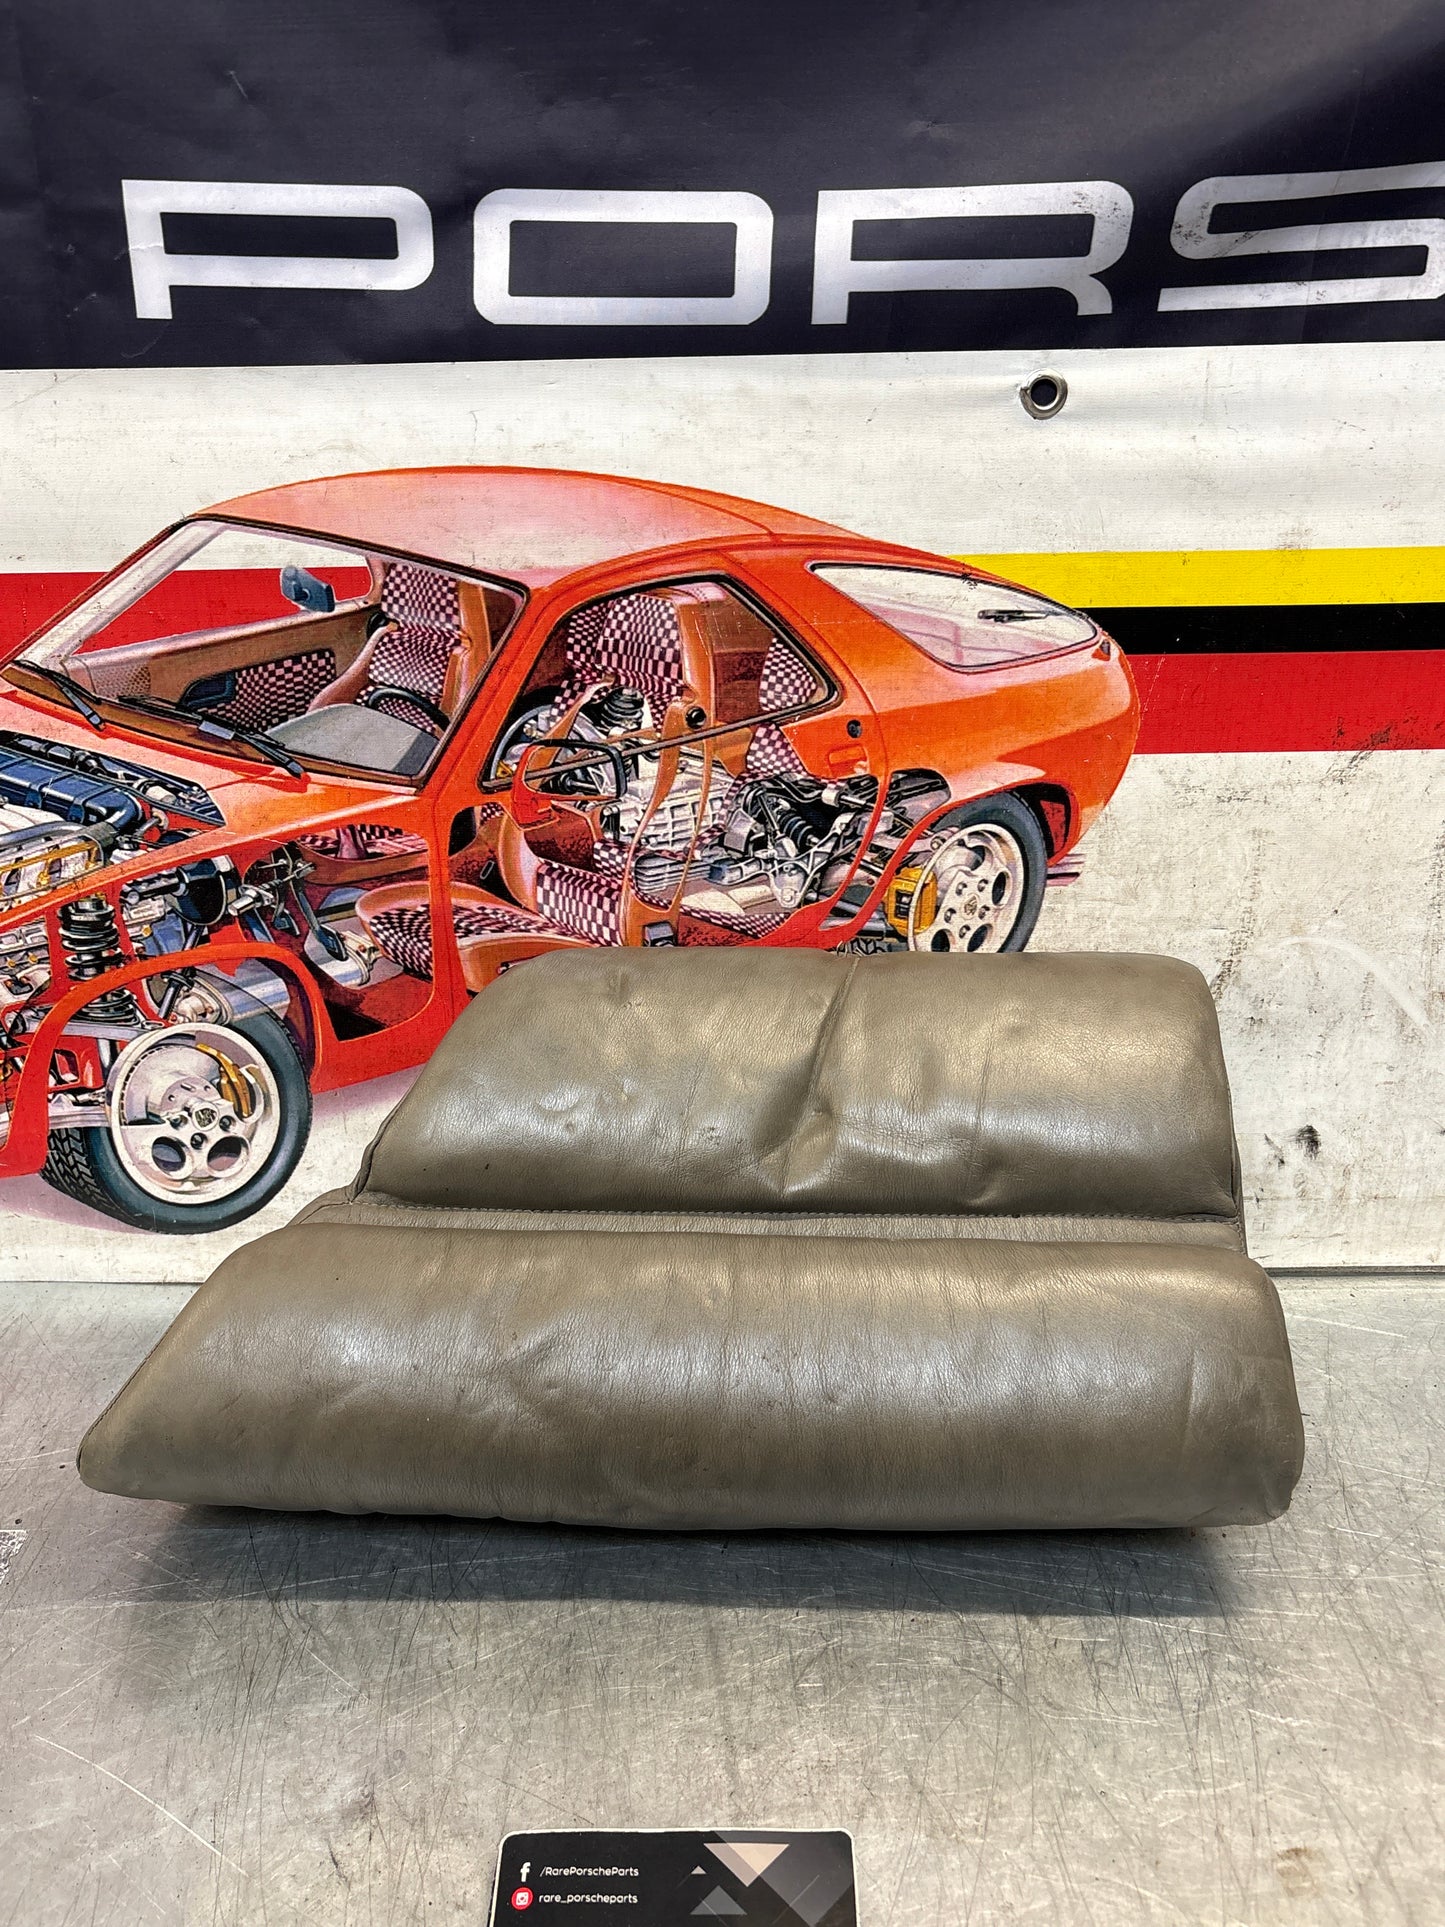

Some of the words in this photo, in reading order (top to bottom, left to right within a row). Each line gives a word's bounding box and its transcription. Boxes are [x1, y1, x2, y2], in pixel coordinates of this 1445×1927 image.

[121, 160, 1445, 326] PORS
[539, 1866, 640, 1878] /RarePorscheParts
[538, 1892, 639, 1905] rare_porscheparts
